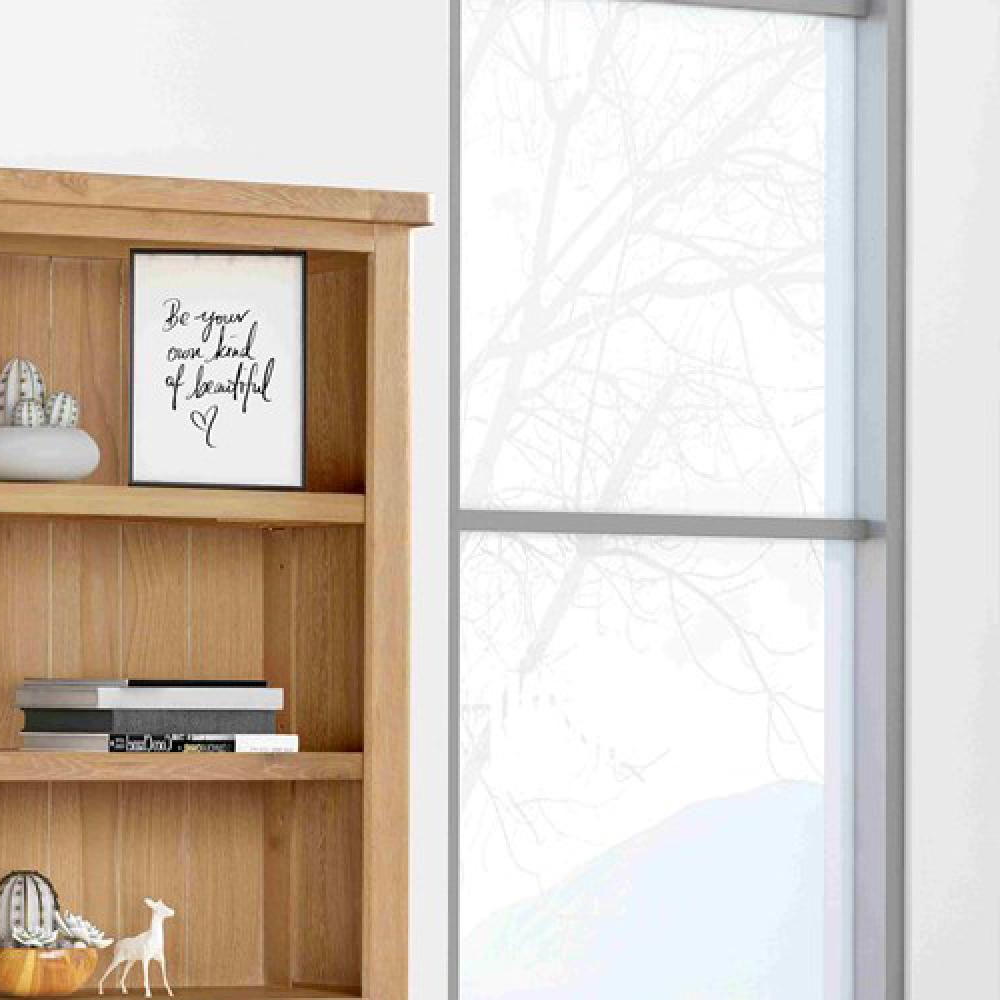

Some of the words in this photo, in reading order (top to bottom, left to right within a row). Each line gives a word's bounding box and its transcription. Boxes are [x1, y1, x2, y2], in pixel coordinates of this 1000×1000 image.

[162, 298, 190, 332] Be
[194, 309, 250, 342] your
[204, 320, 258, 363] kind
[186, 358, 275, 414] beautiful
